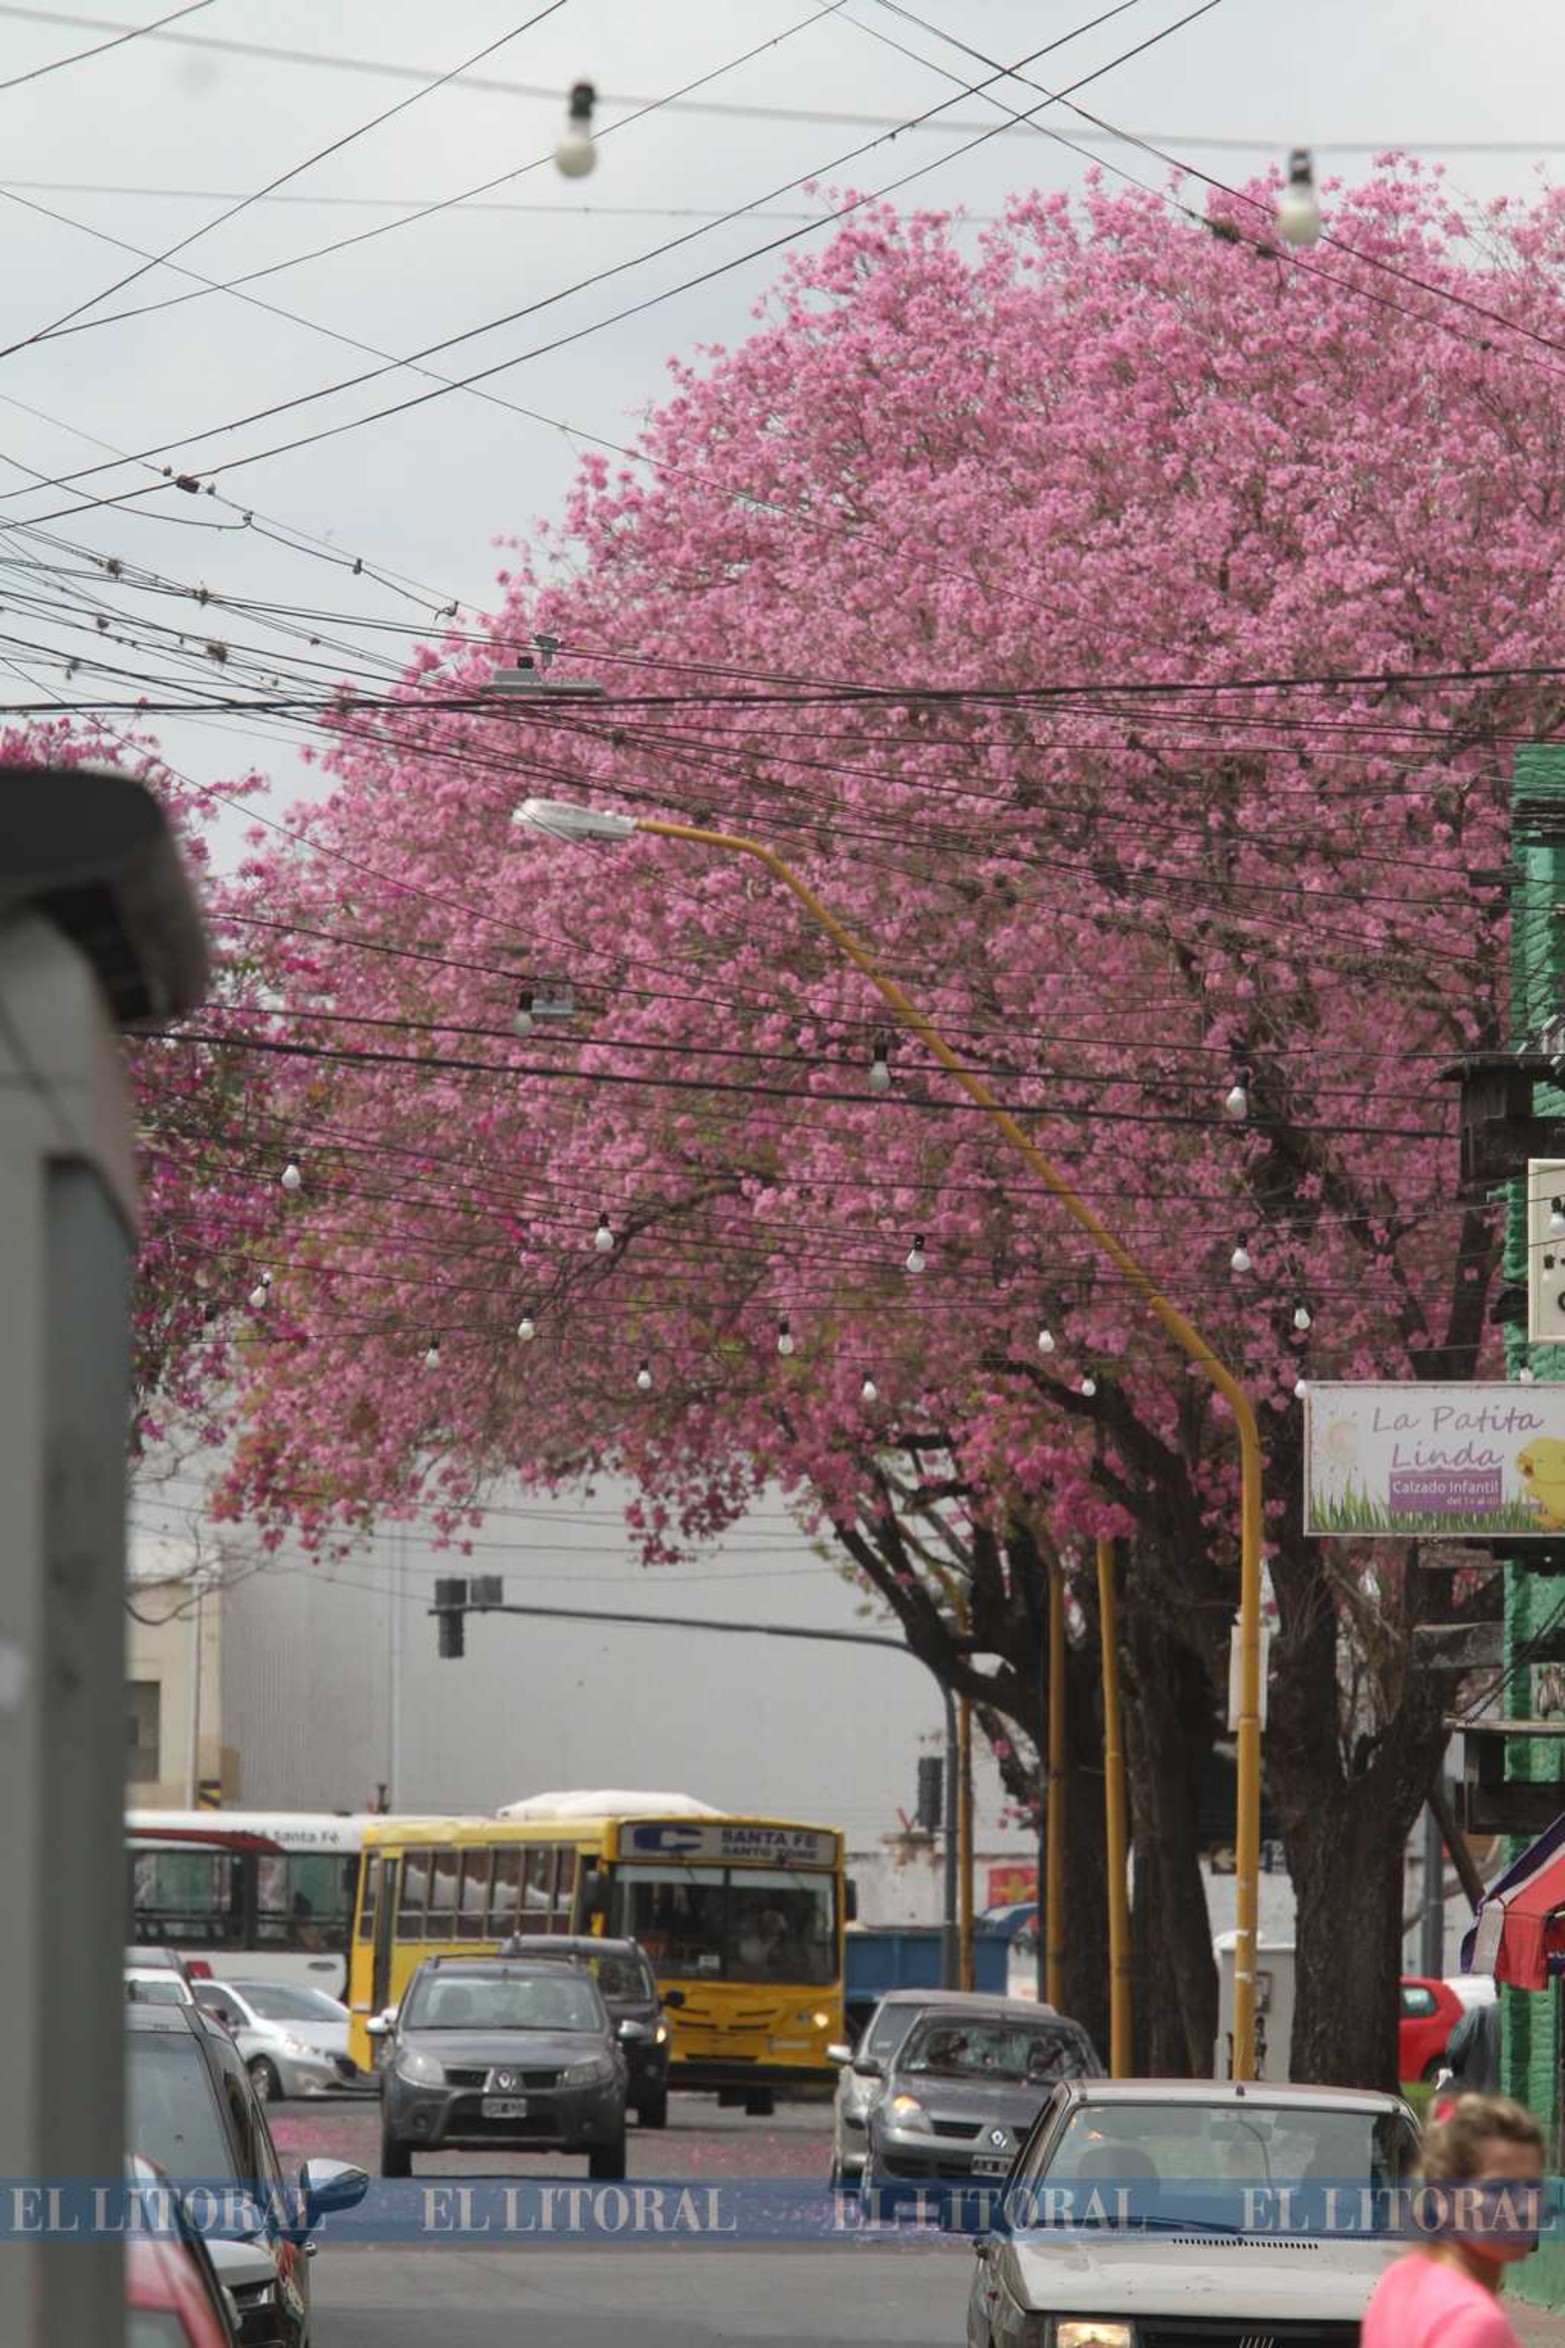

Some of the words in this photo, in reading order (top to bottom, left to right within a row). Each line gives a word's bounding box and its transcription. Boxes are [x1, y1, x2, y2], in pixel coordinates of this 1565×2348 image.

[1372, 1406, 1420, 1432] La
[1431, 1405, 1545, 1434] Patita
[1391, 1440, 1504, 1469] Linda
[1393, 1480, 1446, 1494] Calzado
[1450, 1479, 1498, 1494] Infantil
[273, 1830, 316, 1842] Santa
[722, 1829, 789, 1847] SANTA
